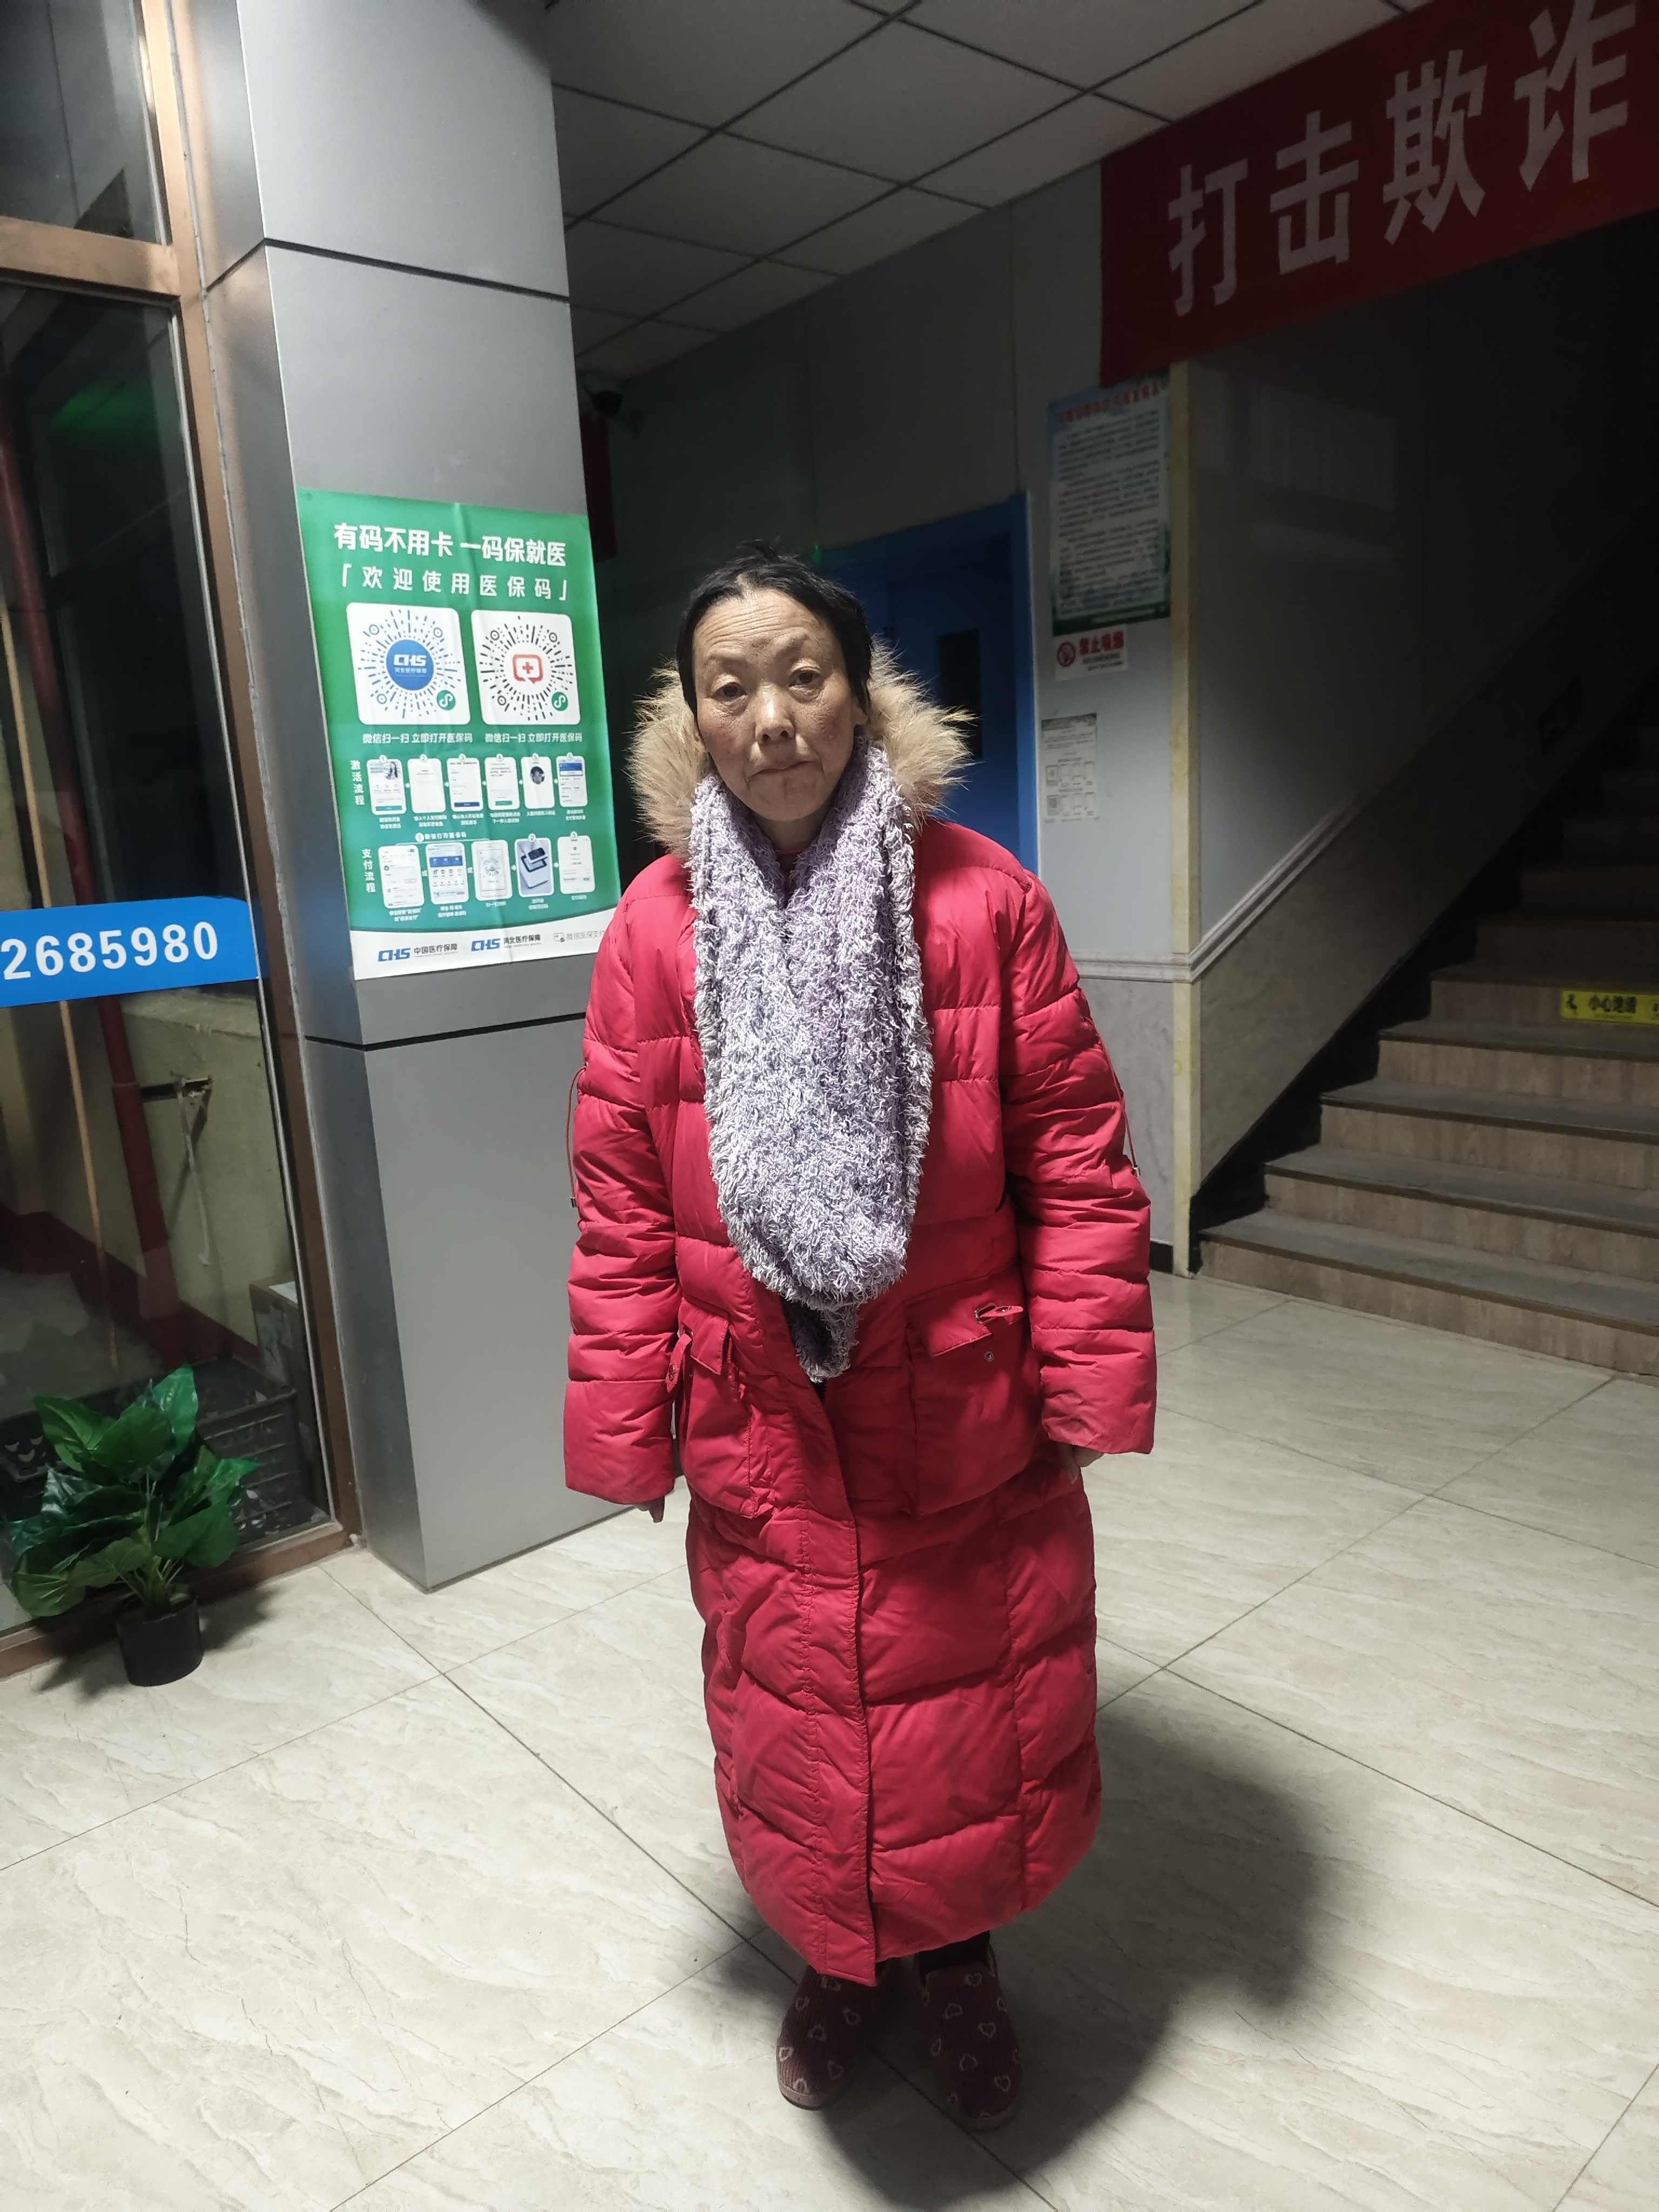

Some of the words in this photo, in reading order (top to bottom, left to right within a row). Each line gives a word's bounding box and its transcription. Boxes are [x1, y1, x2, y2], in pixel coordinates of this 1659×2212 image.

[1168, 0, 1636, 317] 打击欺诈
[333, 522, 453, 557] 有码不用卡
[460, 536, 567, 567] 一码保就医
[394, 654, 427, 666] CHS
[363, 733, 410, 744] 微信扫一扫
[412, 733, 473, 744] 立即打开医保码
[485, 733, 527, 743] 微信扫一扫
[528, 732, 582, 743] 立即打开医保码
[349, 759, 365, 806] 激活流程
[361, 848, 376, 893] 支付流程
[1, 921, 218, 980] 2685980
[378, 947, 412, 962] CHS
[414, 943, 458, 955] 中国医疗保障
[471, 939, 500, 952] CHS
[503, 934, 541, 945] 河北医疗保障
